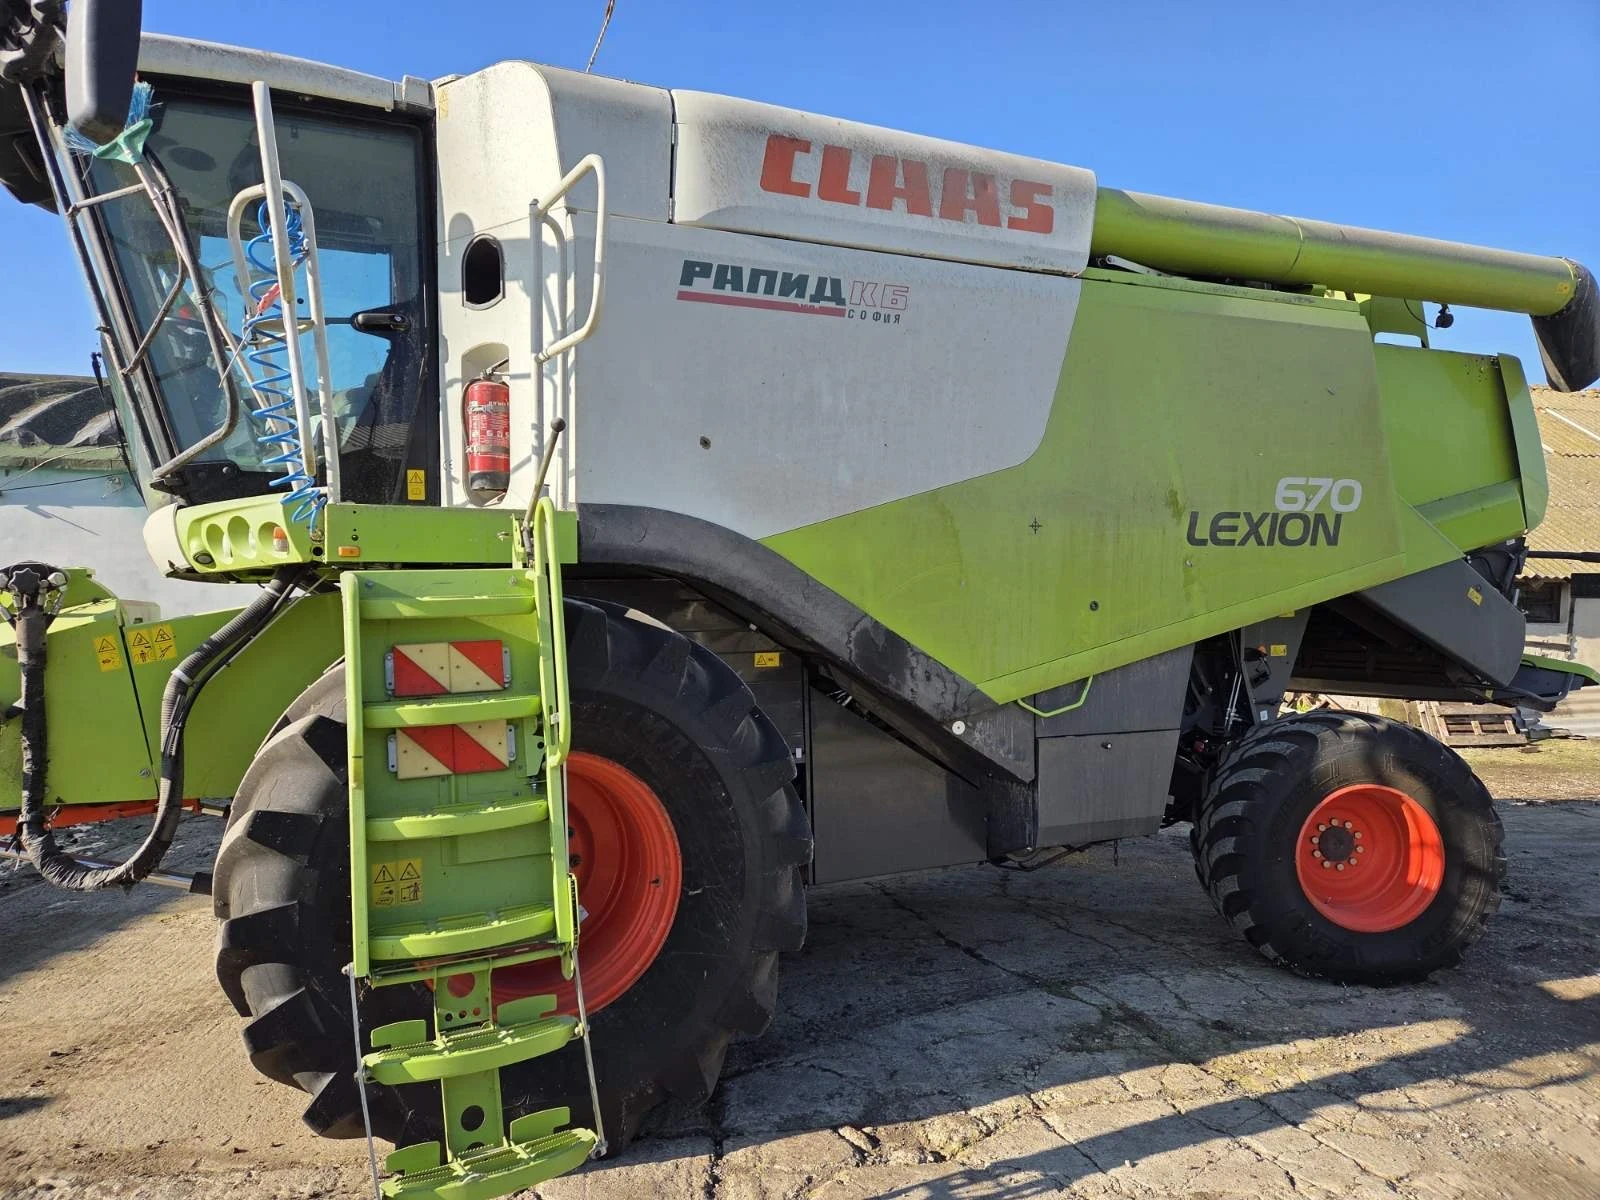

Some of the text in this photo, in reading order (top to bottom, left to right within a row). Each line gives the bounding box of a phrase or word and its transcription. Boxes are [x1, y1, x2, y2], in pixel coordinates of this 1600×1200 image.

[759, 133, 1054, 235] CLAAS
[679, 259, 847, 307] РАПИД
[847, 308, 901, 325] СОФИЯ
[1274, 476, 1362, 513] 670
[1186, 511, 1343, 547] LEXION
